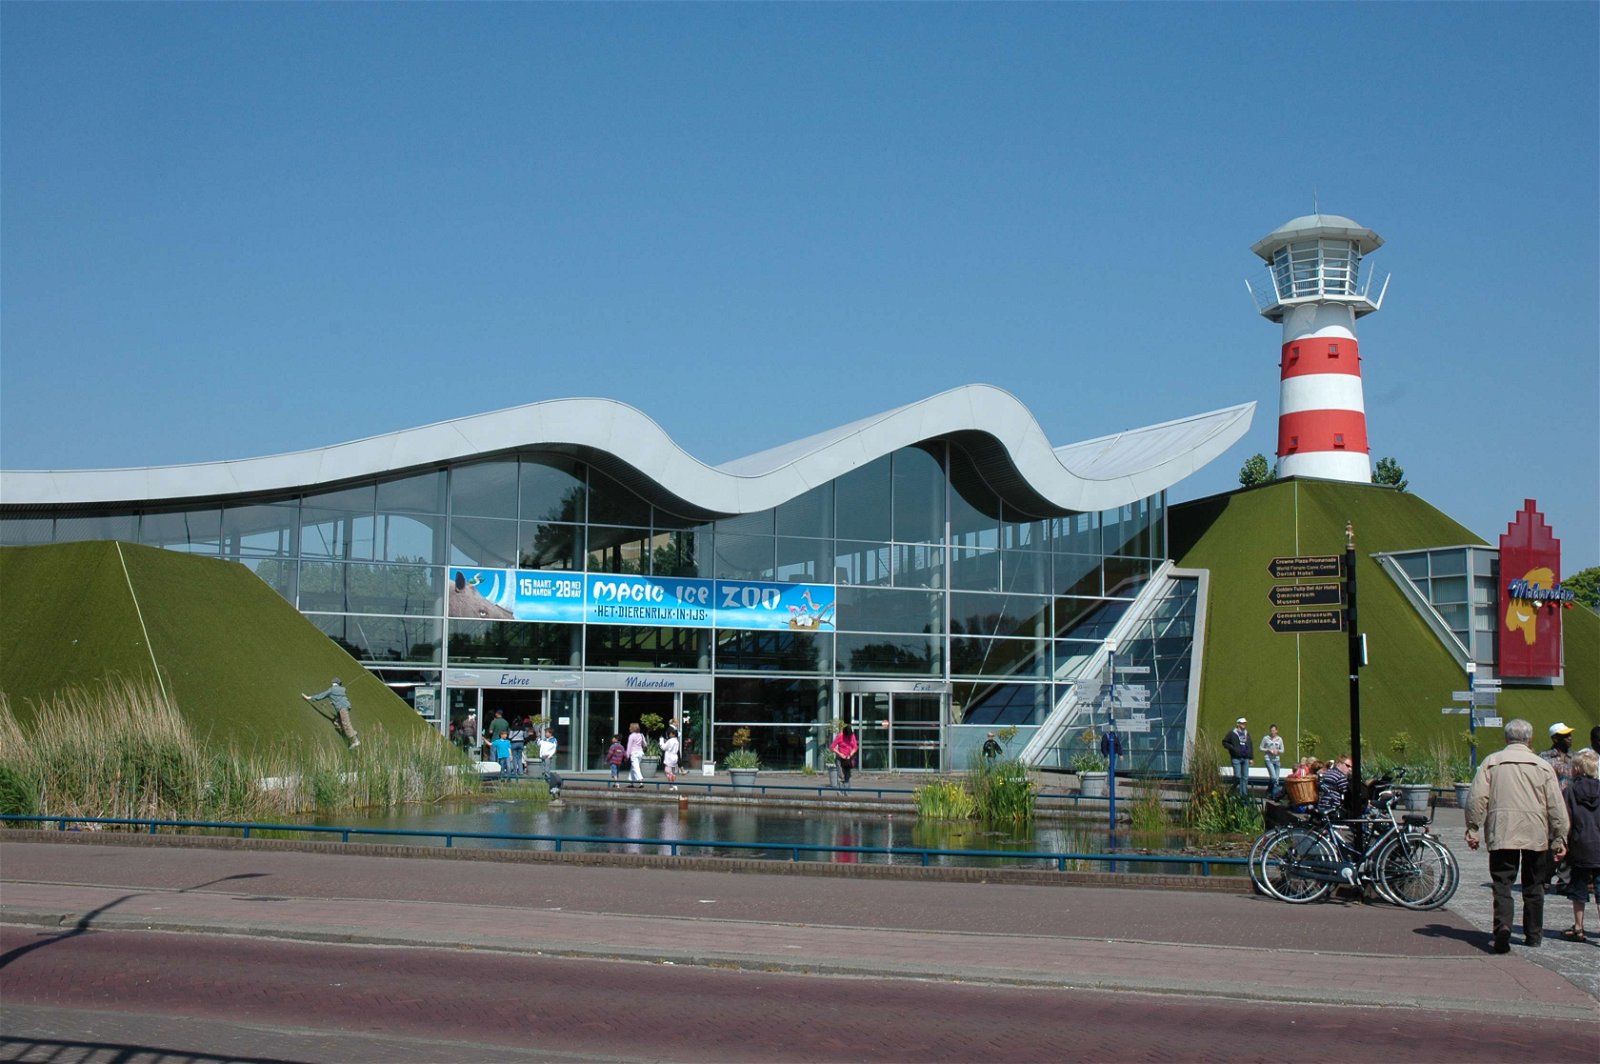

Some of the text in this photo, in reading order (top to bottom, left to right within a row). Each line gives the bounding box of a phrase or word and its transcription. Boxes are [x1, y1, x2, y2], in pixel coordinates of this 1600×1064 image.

[520, 579, 532, 596] 15
[533, 580, 552, 588] MAART
[532, 588, 552, 596] MARCH
[1508, 578, 1574, 599] Madurodam
[593, 581, 664, 603] MAGIC
[722, 586, 780, 610] ZOO
[598, 605, 705, 620] HET DIERENRIJK IN IJS
[626, 676, 675, 688] Madurodam
[913, 683, 931, 691] Exit
